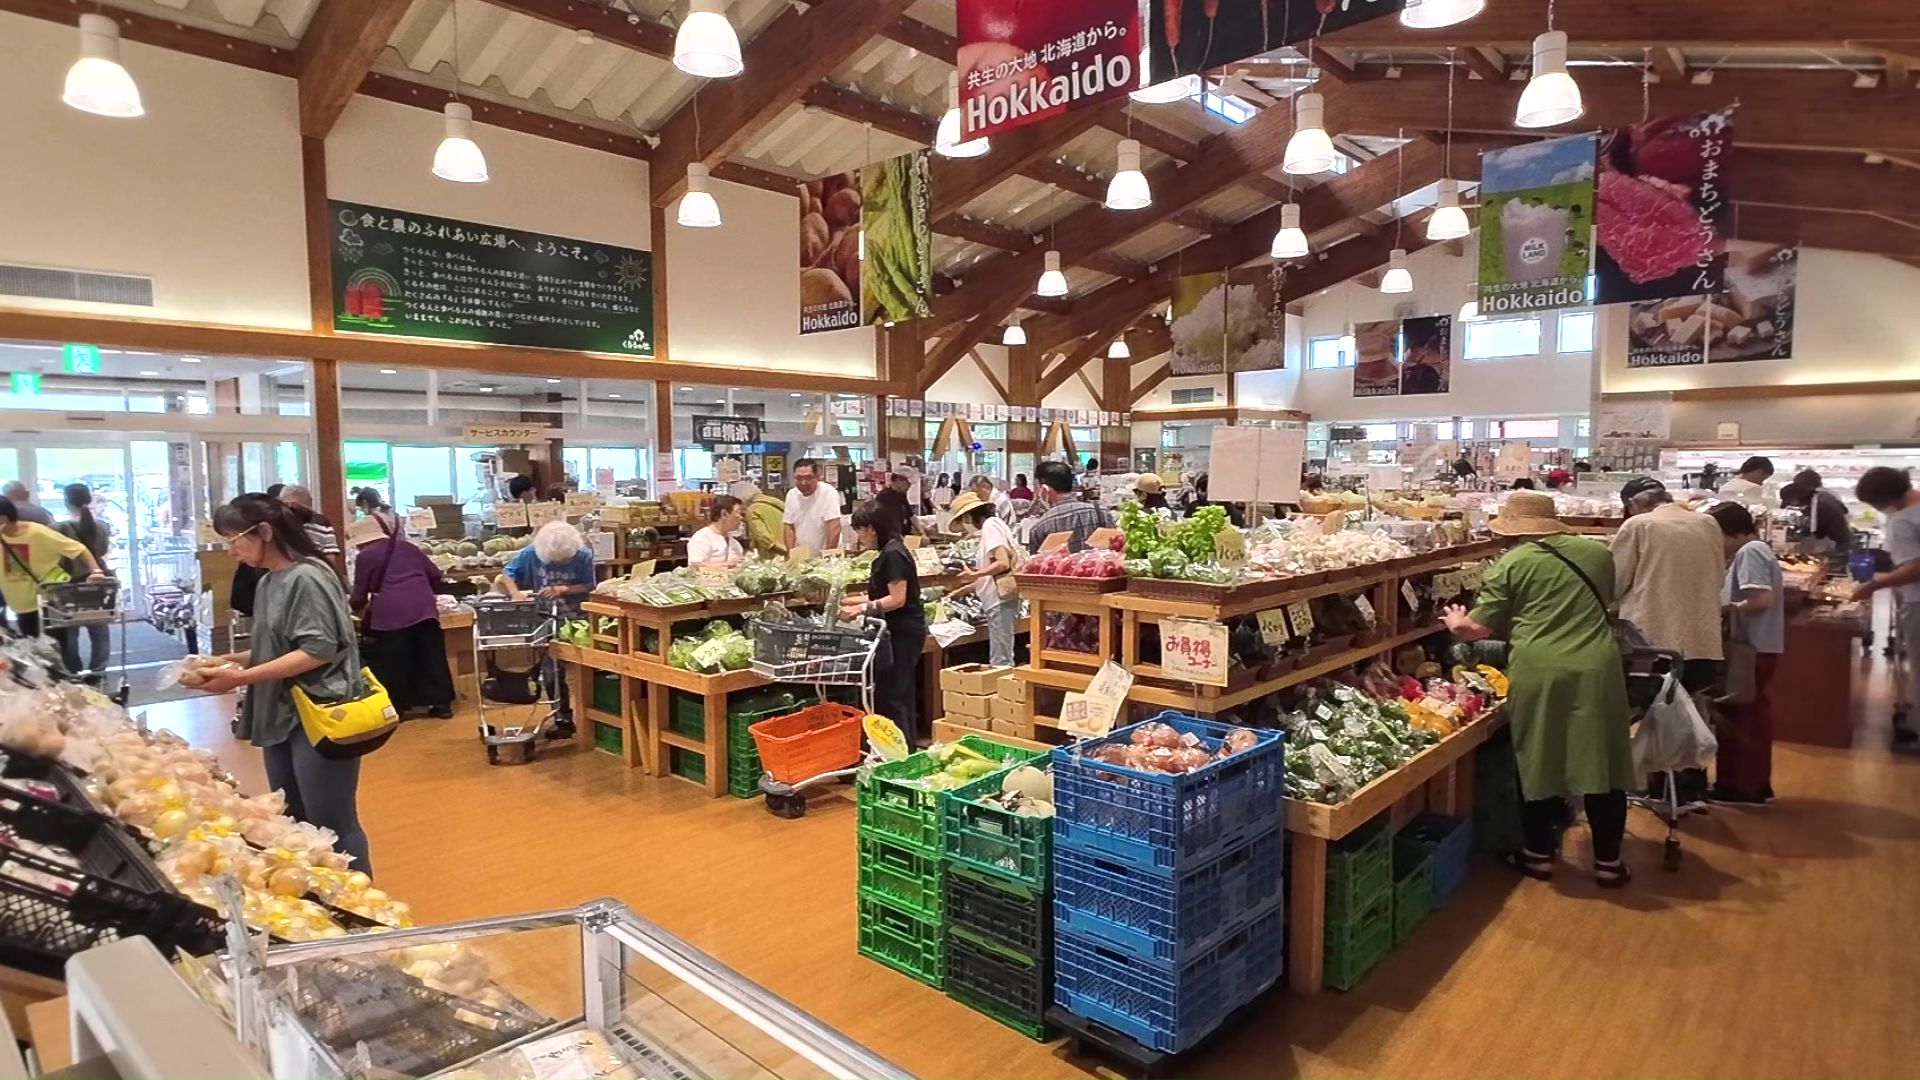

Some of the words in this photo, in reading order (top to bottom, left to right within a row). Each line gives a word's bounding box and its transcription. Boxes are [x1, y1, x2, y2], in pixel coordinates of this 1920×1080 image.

[967, 50, 1038, 90] 共生の大地
[1040, 20, 1128, 63] 北海道から。
[967, 53, 1132, 132] Hokkaido
[1691, 139, 1724, 290] おまちどうさん
[1523, 250, 1546, 260] LAND
[1524, 242, 1545, 252] MILK
[1482, 287, 1583, 313] Hokkaido
[803, 310, 858, 331] Hokkaido
[1631, 351, 1701, 366] Hokkaido
[1172, 362, 1222, 375] Hokkaido
[470, 429, 538, 438] サービスカウンター
[1166, 634, 1212, 658] お買得
[1187, 656, 1217, 669] コーナー
